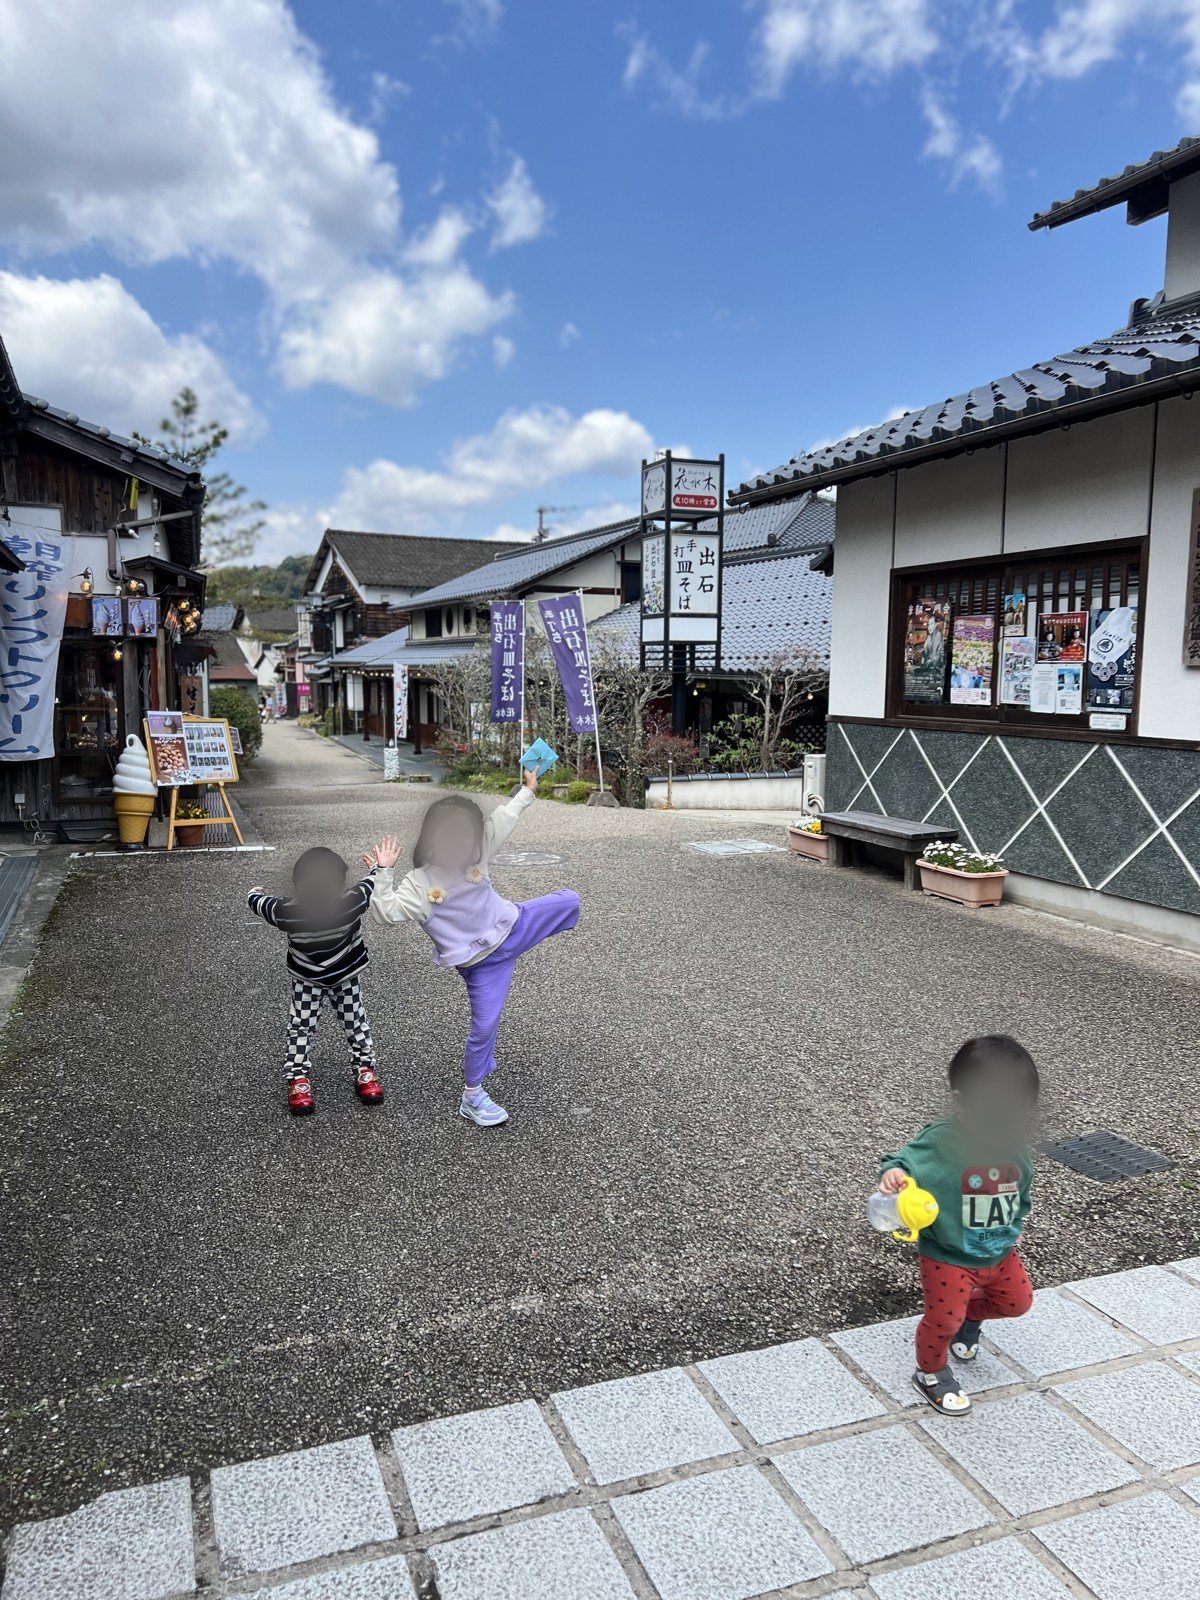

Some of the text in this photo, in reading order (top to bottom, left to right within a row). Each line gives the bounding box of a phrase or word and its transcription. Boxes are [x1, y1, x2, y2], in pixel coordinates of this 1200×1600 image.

[674, 467, 717, 491] 花水木
[697, 546, 715, 594] 出石
[969, 1194, 1017, 1228] LAY
